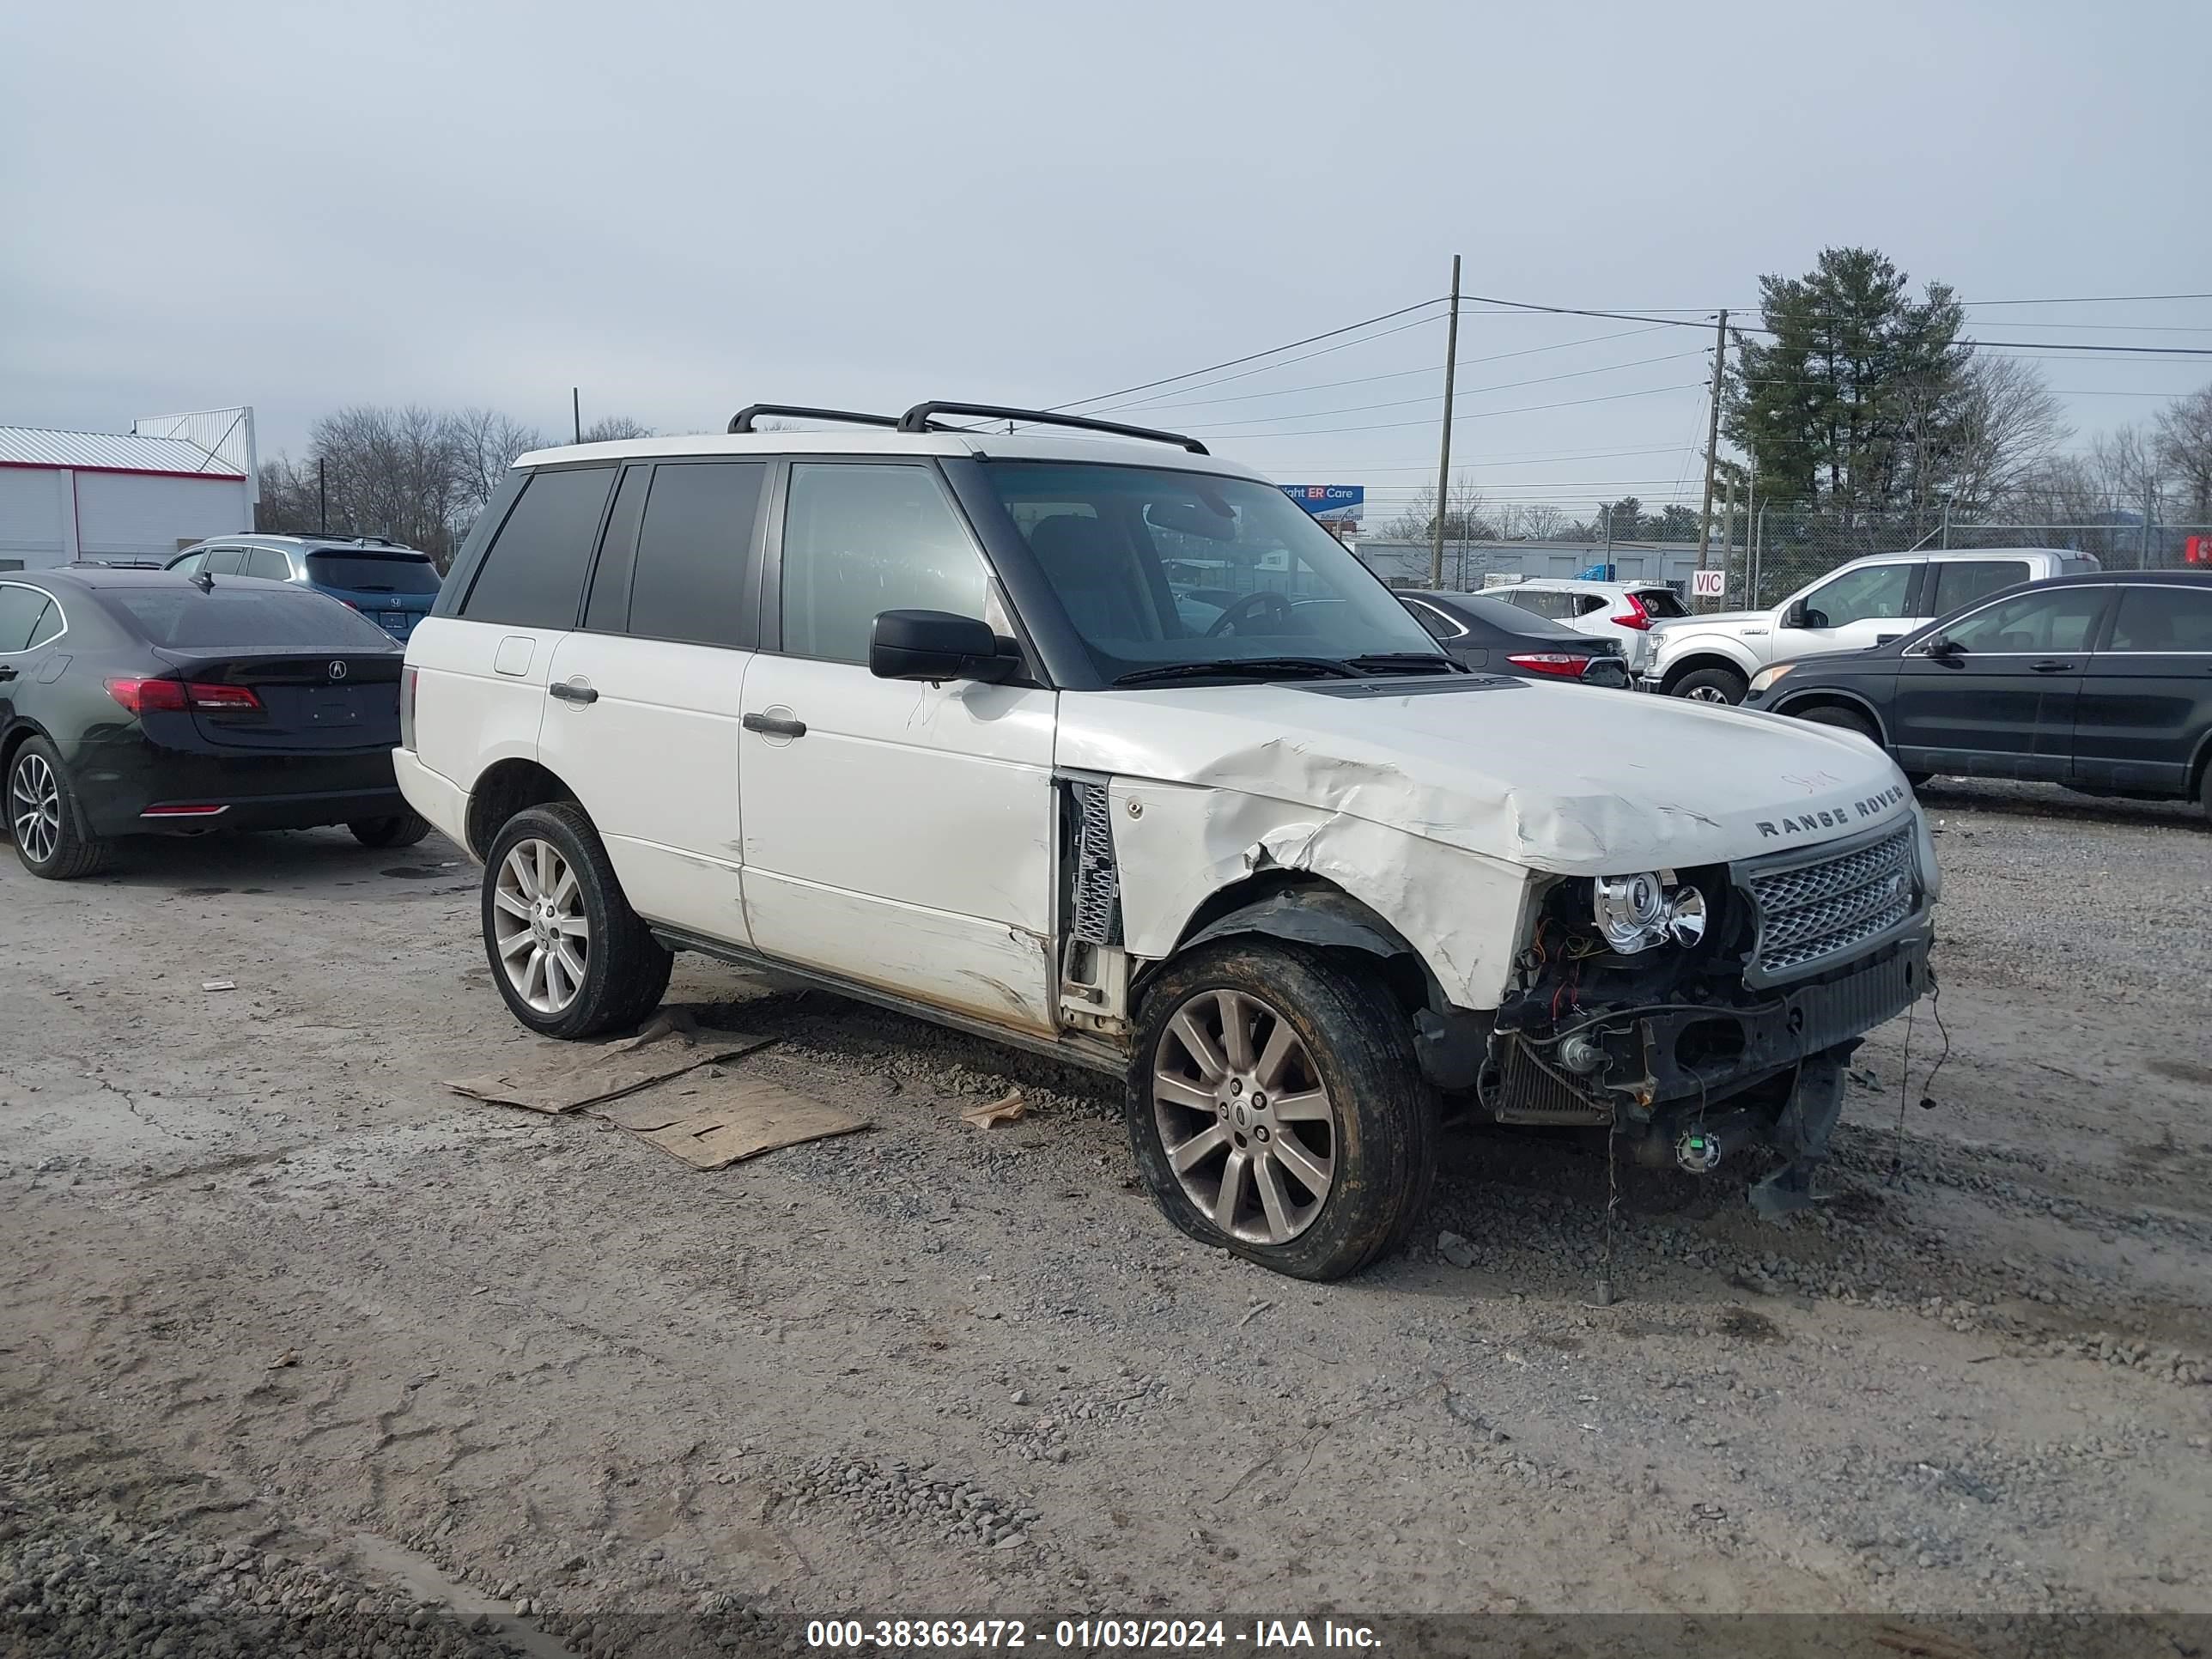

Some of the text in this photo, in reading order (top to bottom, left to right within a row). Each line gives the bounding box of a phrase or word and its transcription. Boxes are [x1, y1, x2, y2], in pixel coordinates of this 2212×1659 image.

[1282, 487, 1353, 499] ight ER Care
[1696, 573, 1722, 592] VIC
[1755, 784, 1904, 838] RANGE ROVER
